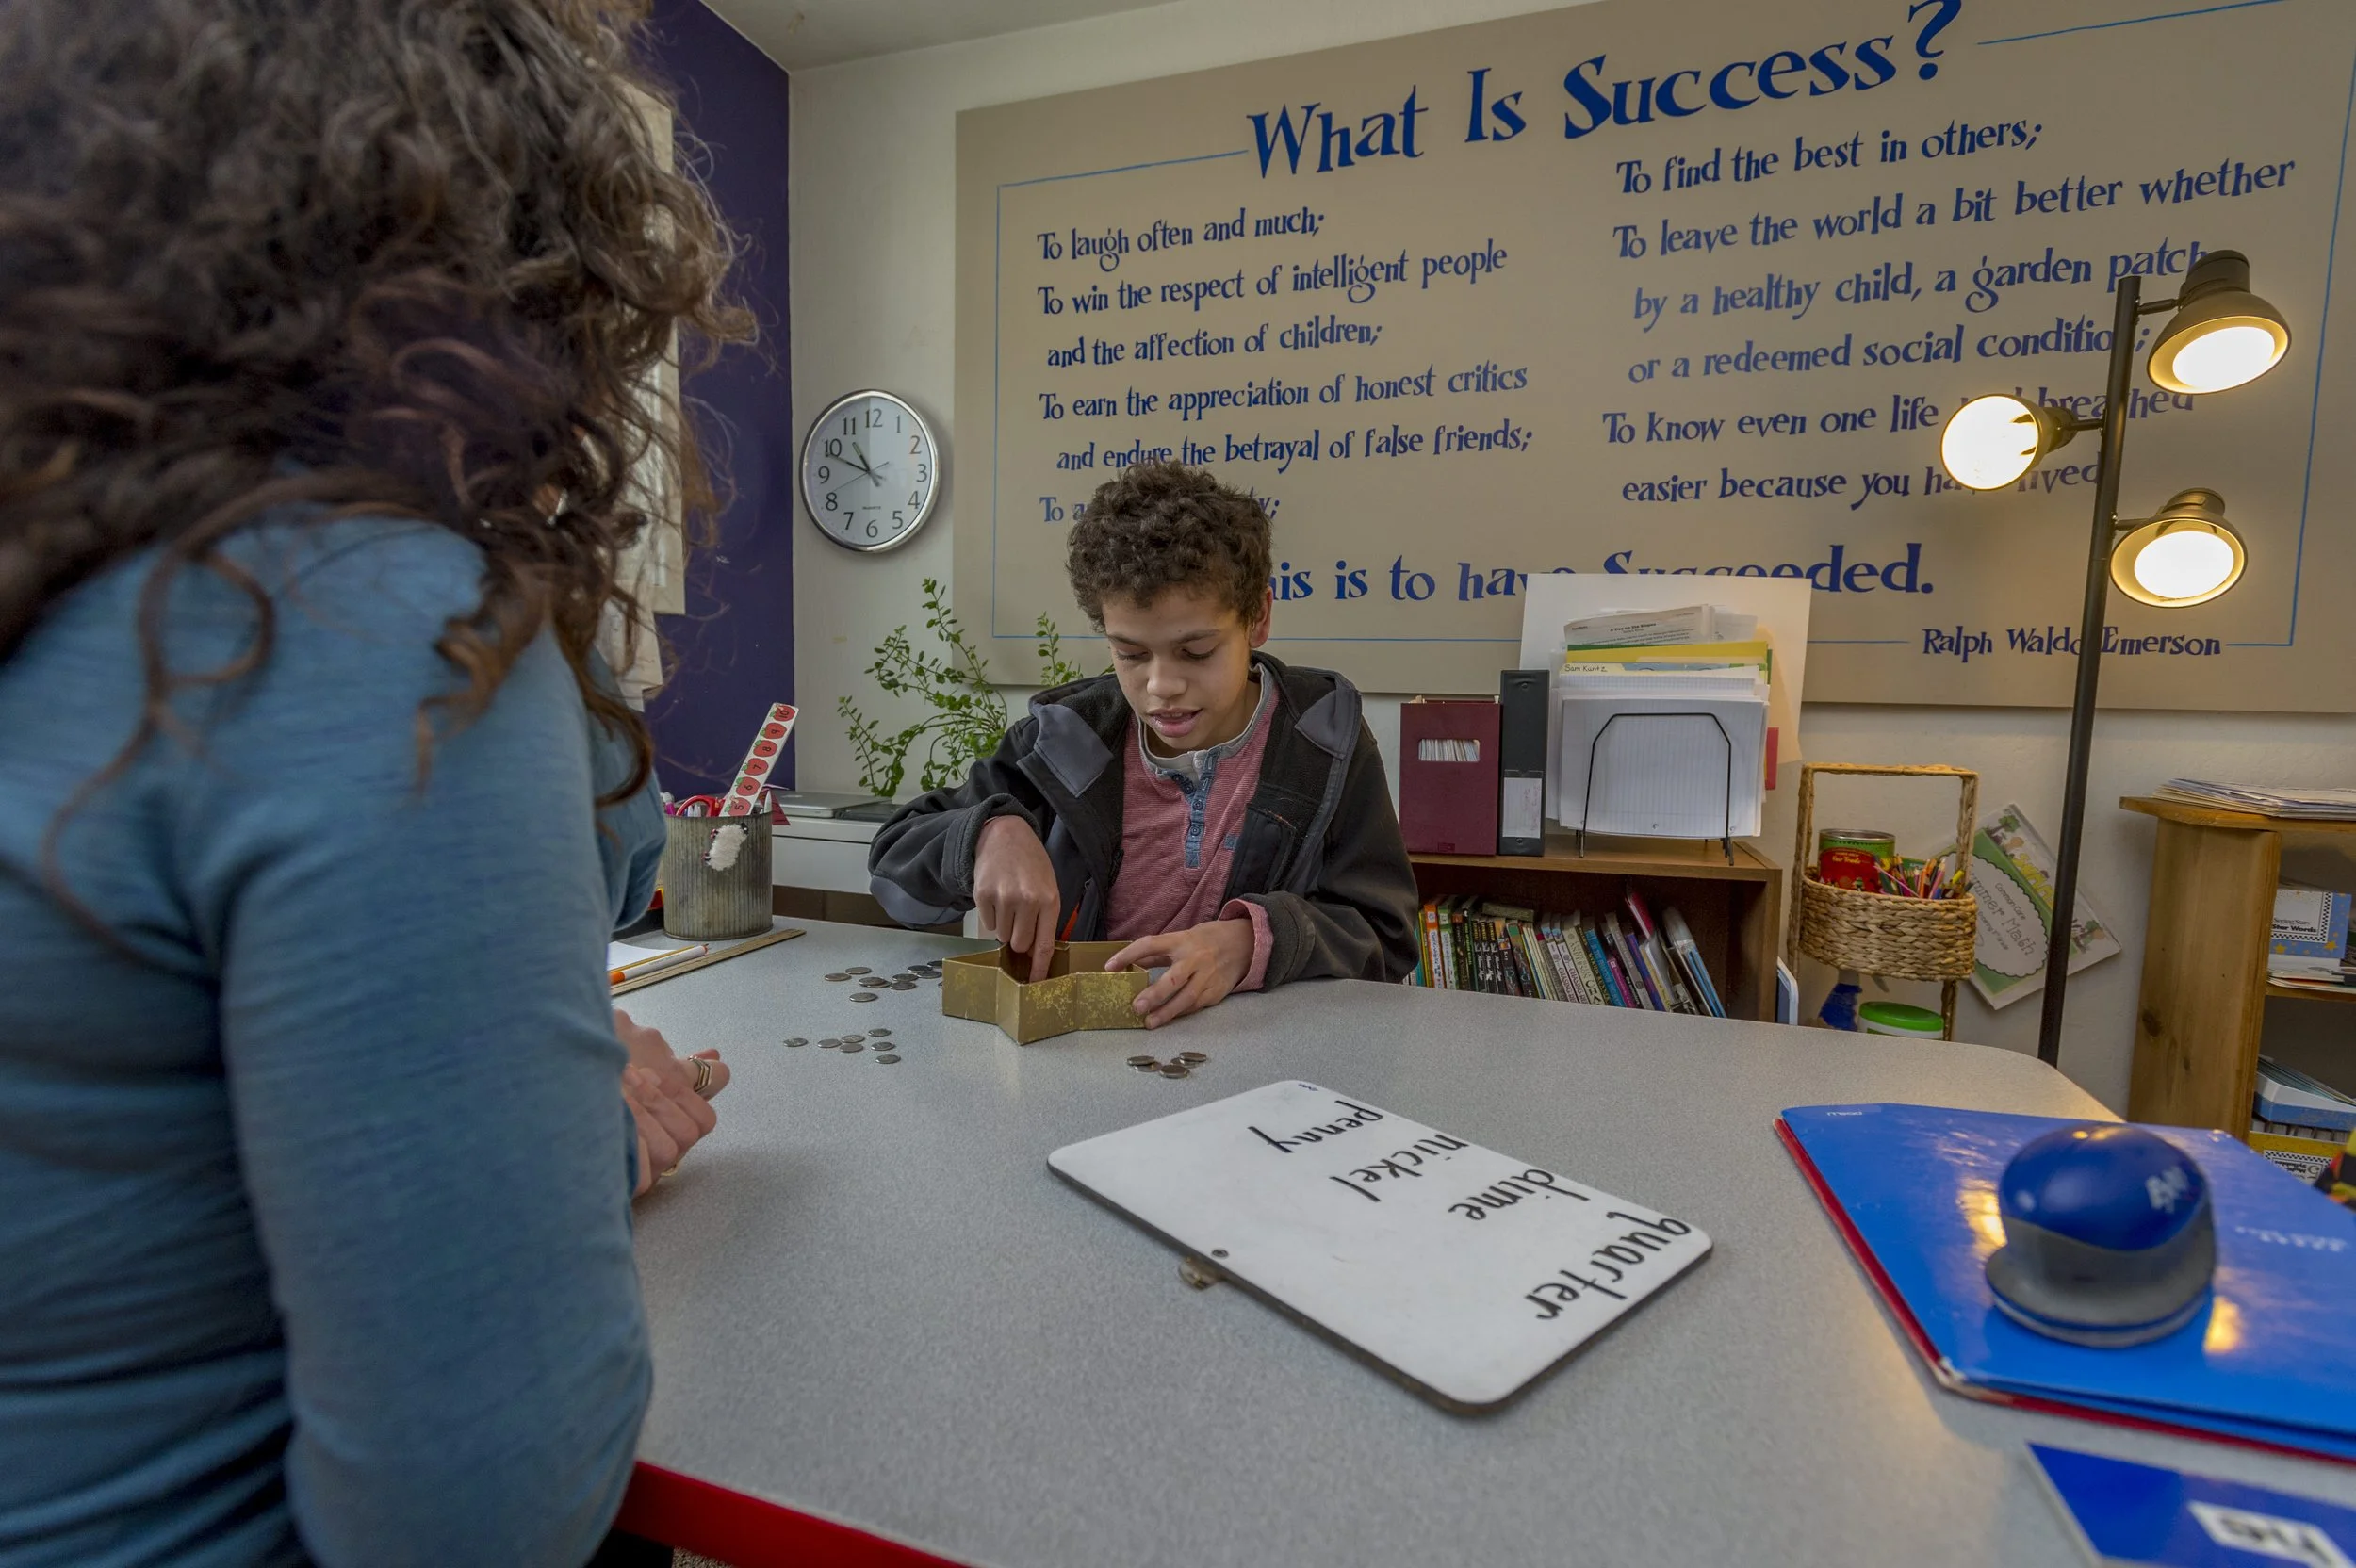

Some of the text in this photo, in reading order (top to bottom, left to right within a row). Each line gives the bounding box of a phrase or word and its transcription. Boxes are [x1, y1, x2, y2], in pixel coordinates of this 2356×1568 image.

[1246, 0, 1962, 179] What Is Success?
[1616, 121, 2042, 194] To find the best in others;
[1613, 160, 2296, 259] To leave the world a bit better whether
[1040, 206, 1324, 272] To laugh often and much;
[1038, 238, 1508, 315] To win the respect of intelligent people
[1634, 287, 1668, 333] by
[1680, 294, 1699, 314] a
[1712, 273, 1820, 320] healthy
[1835, 261, 1922, 304] child,
[1934, 270, 1956, 292] a
[1965, 247, 2092, 312] garden
[1047, 314, 1383, 368] and the affection of children;
[1628, 317, 2150, 384] or a redeemed social conditio;
[1040, 362, 1528, 422] To earn the appreciation of honest critics
[843, 416, 856, 435] 11
[865, 408, 883, 428] 12
[895, 415, 901, 433] 1
[1602, 412, 1635, 444] To
[1646, 411, 1723, 442] know
[1737, 413, 1807, 437] even
[1820, 408, 1877, 433] one
[1890, 394, 1938, 433] life
[2038, 387, 2193, 418] breahed
[825, 438, 842, 457] 10
[908, 435, 922, 454] 2
[1056, 418, 1532, 475] and endure the betrayal of false friends;
[818, 466, 830, 483] 9
[916, 463, 927, 482] 3
[1622, 475, 1708, 502] easier
[1719, 467, 1847, 498] because
[1850, 474, 1909, 511] you
[825, 492, 838, 511] 8
[908, 490, 920, 509] 4
[1039, 497, 1064, 522] To
[843, 511, 854, 530] 7
[866, 519, 878, 538] 6
[892, 510, 903, 529] 5
[1269, 561, 1313, 601] is
[1335, 559, 1368, 601] is
[1389, 554, 1436, 601] to
[1922, 626, 1992, 663] Ralph
[2101, 626, 2221, 657] Emerson
[1564, 663, 1582, 673] Sam
[778, 710, 790, 718] 10
[2001, 918, 2037, 956] Math
[1569, 941, 1588, 980] ANDERSON
[1557, 966, 1573, 995] CHASING
[1567, 967, 1582, 995] CHASING
[1248, 1100, 1383, 1153] penny
[1330, 1134, 1468, 1201] nickel
[1448, 1169, 1589, 1220] dime
[1526, 1211, 1691, 1319] quarter
